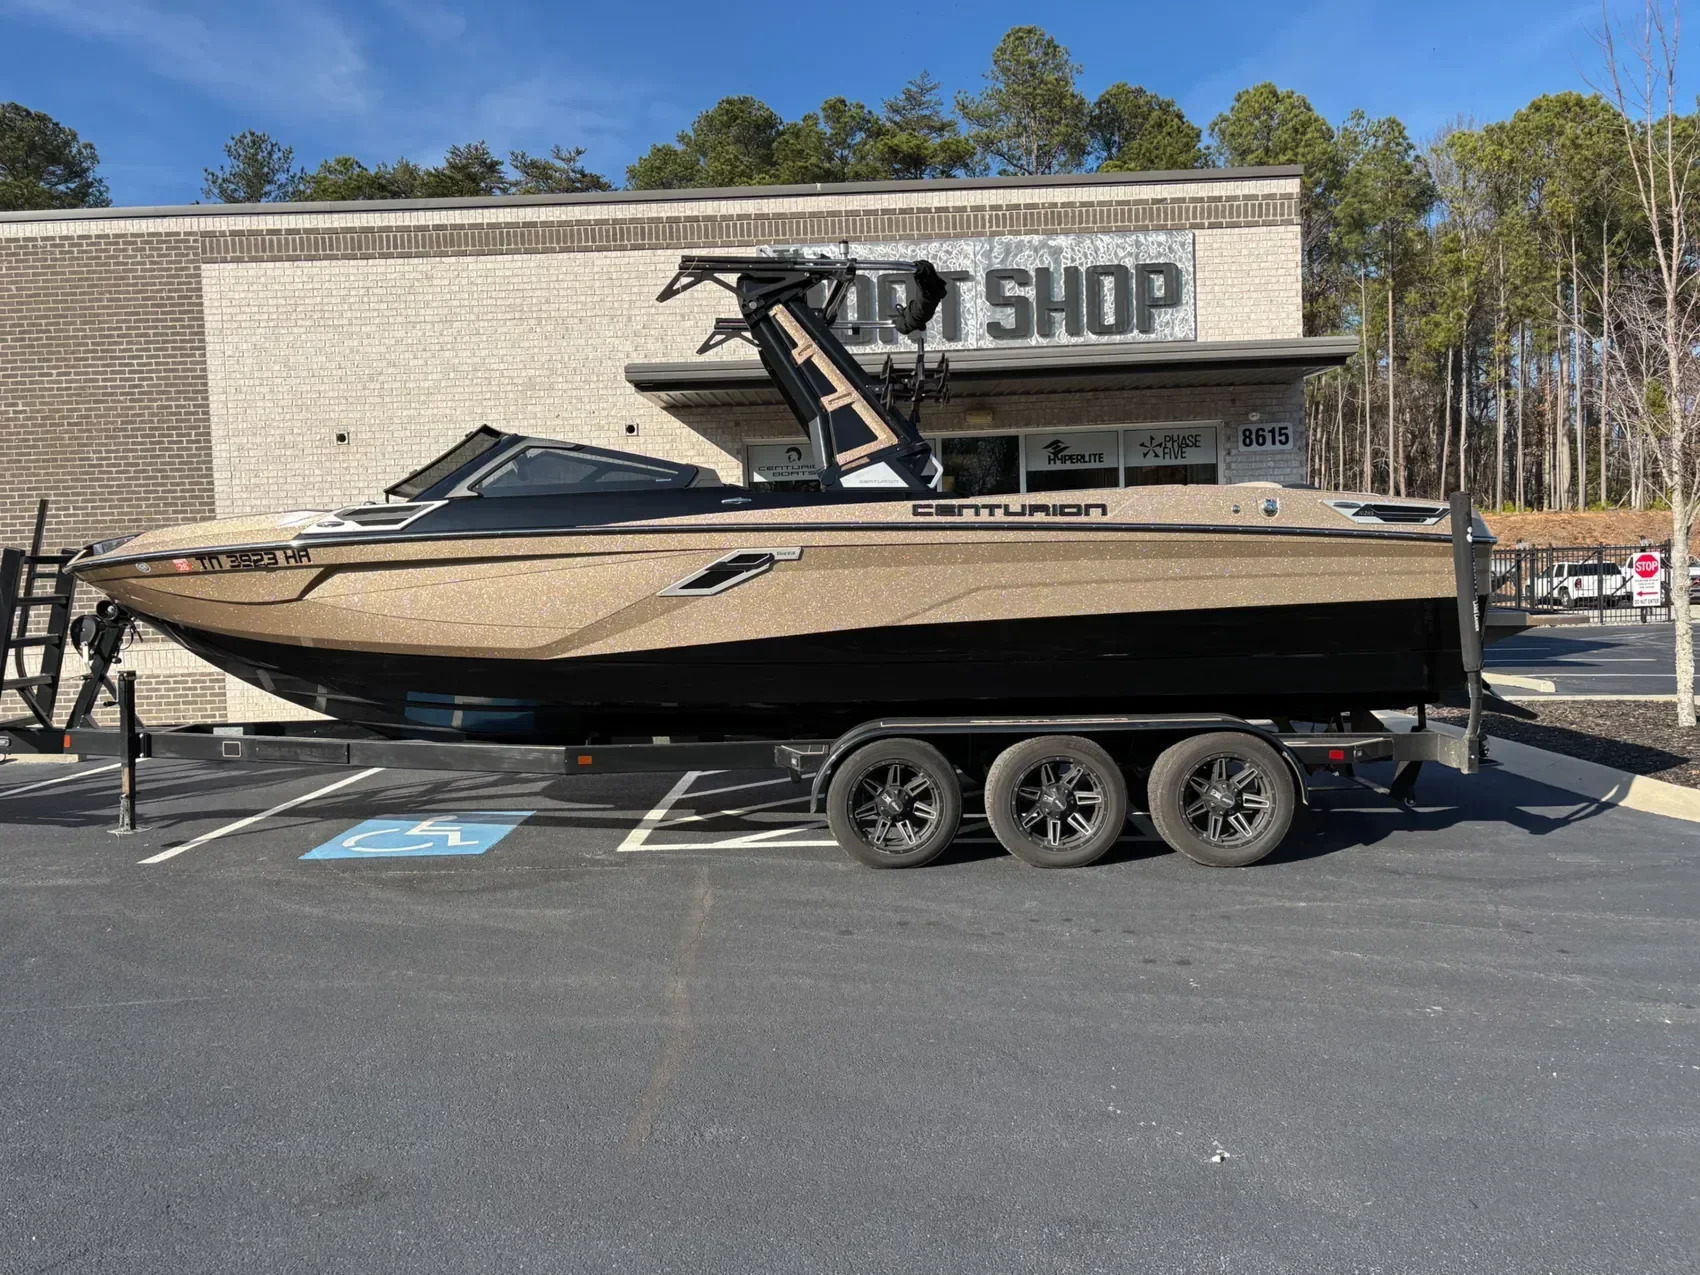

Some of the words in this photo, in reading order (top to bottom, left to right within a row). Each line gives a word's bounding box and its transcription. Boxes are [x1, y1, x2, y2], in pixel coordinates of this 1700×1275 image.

[806, 269, 970, 345] OAT
[986, 263, 1180, 339] SHOP
[1164, 434, 1202, 449] PHASE
[1242, 426, 1290, 447] 8615
[1047, 452, 1104, 465] HYPERLITE
[1162, 447, 1187, 460] FIVE
[911, 504, 1108, 517] CENTURION
[195, 555, 223, 570] TN
[226, 551, 279, 569] 3923
[284, 548, 312, 565] HA
[1635, 561, 1658, 571] STOP
